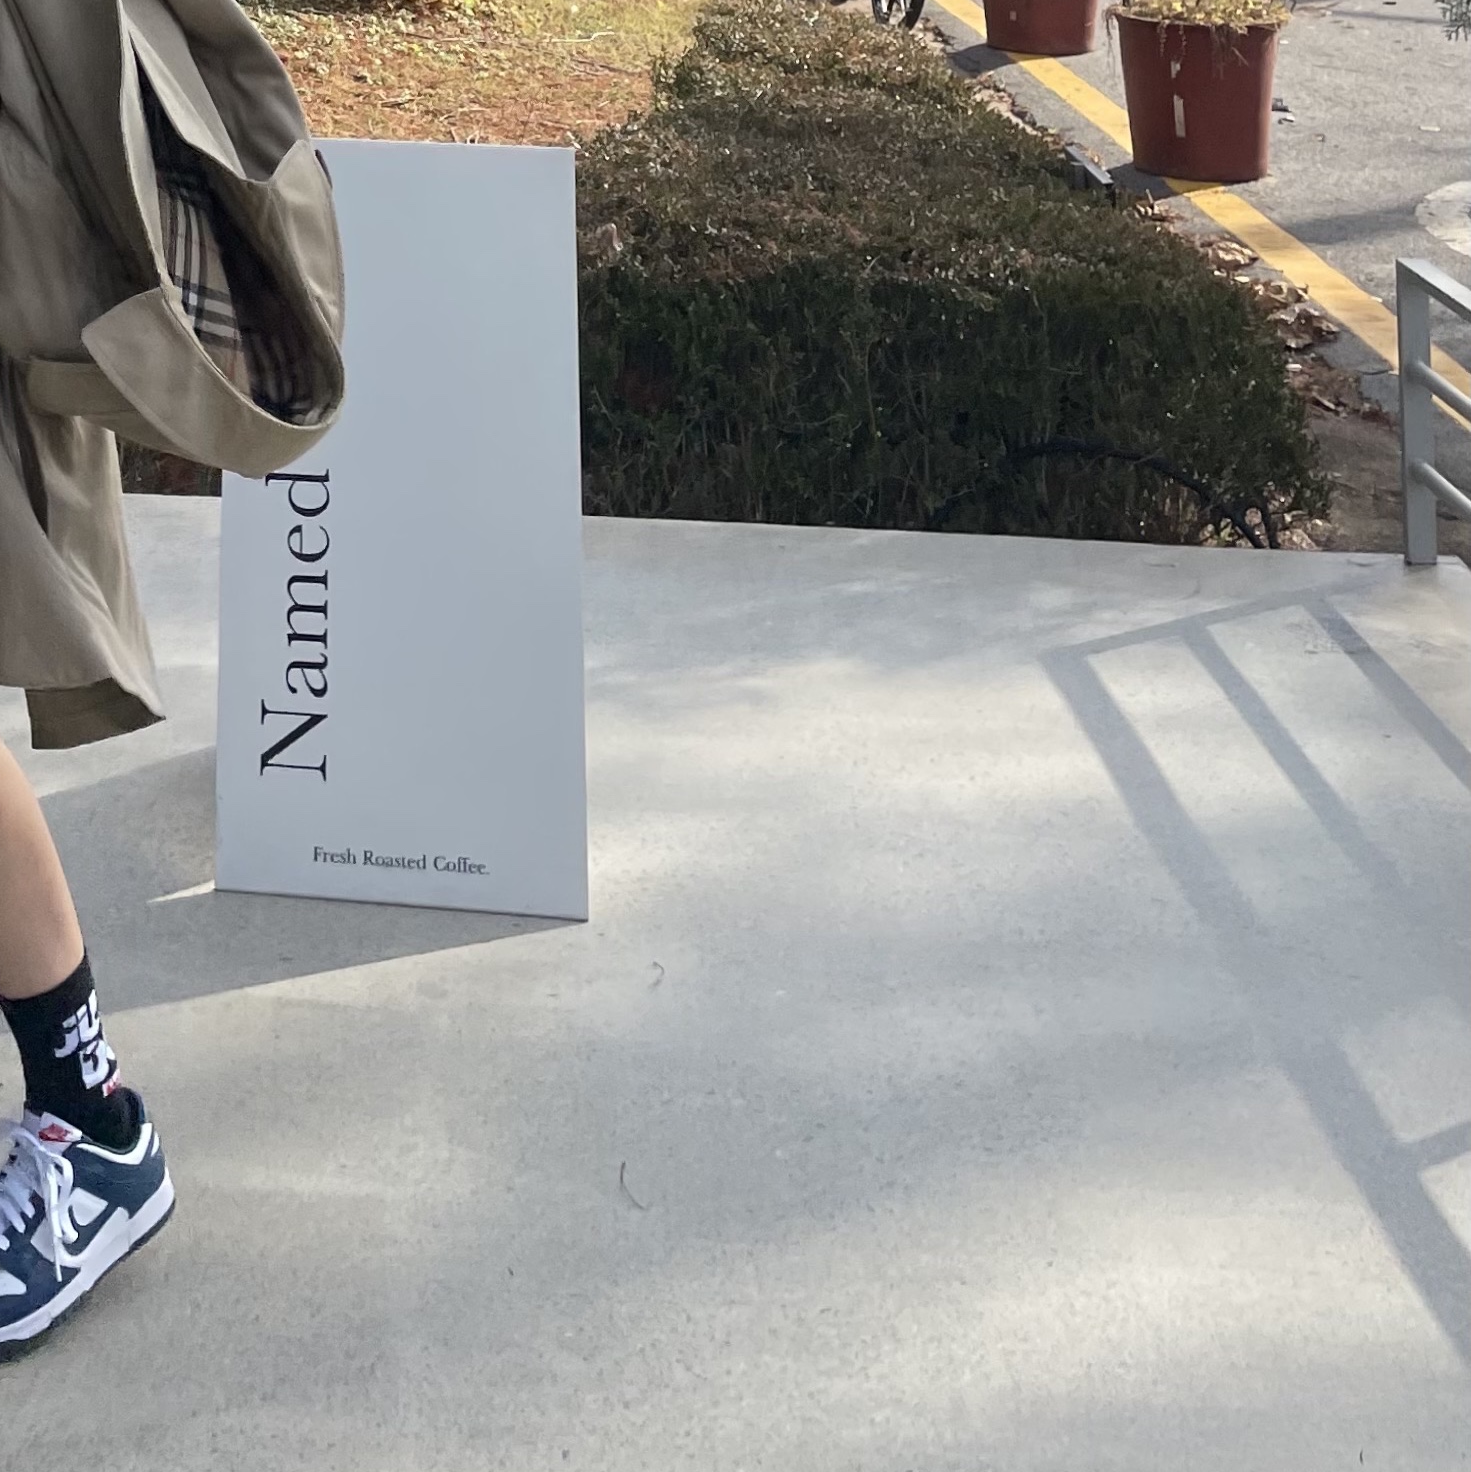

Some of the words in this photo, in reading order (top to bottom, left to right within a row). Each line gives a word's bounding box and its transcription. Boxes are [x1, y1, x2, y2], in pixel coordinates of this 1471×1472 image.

[259, 468, 330, 783] Named
[313, 845, 357, 865] Fresh
[362, 849, 427, 871] Roasted
[433, 855, 490, 876] Coffee.
